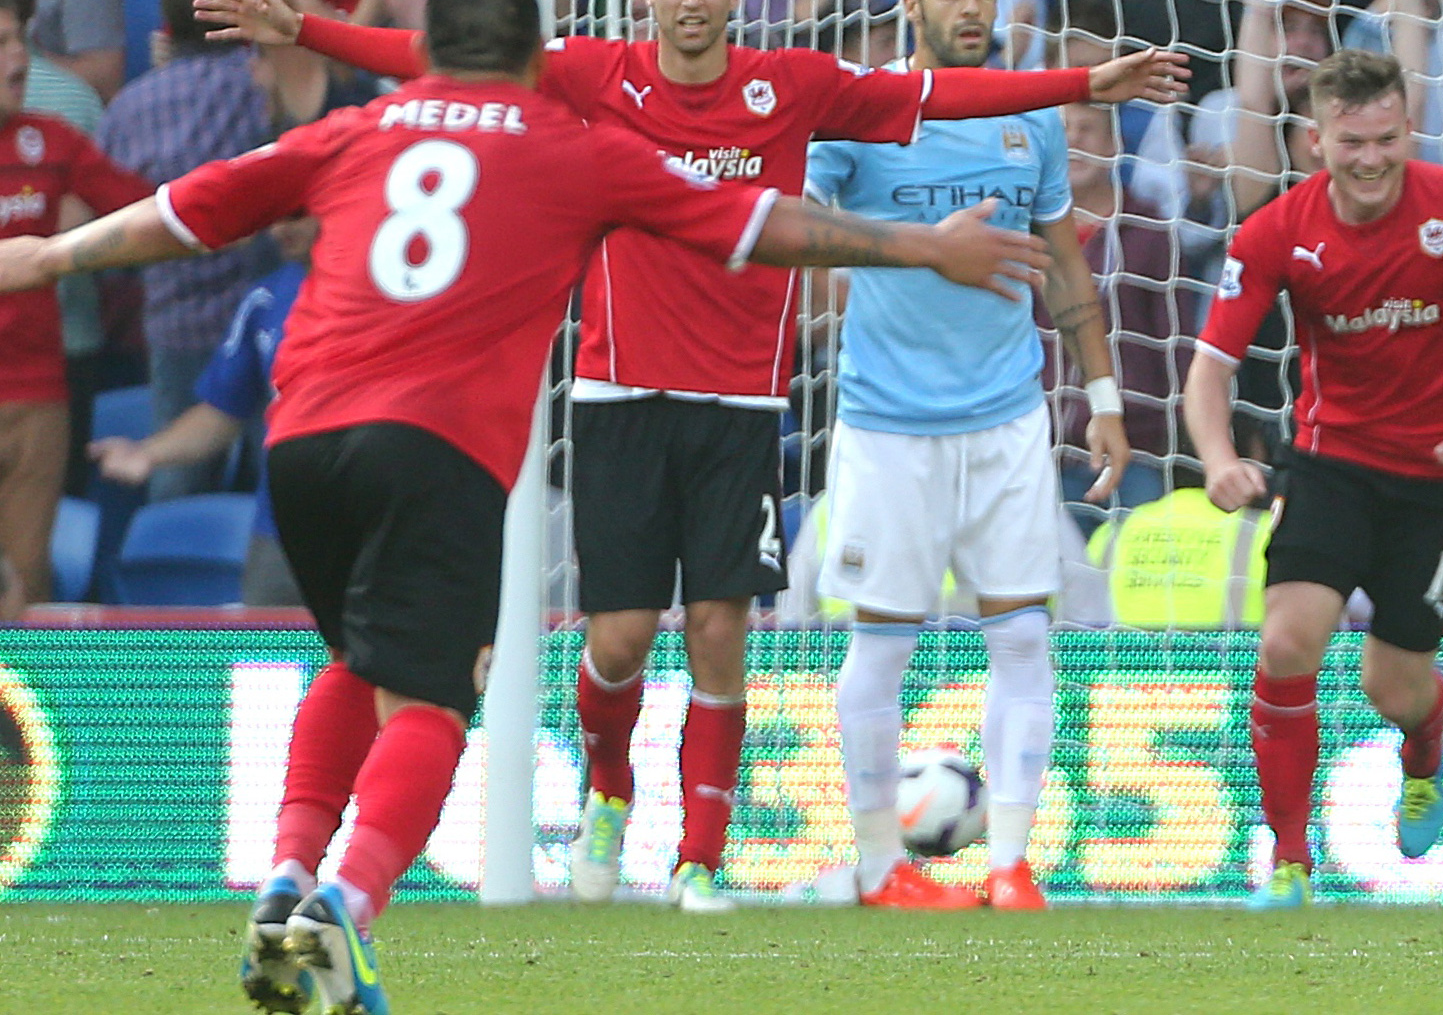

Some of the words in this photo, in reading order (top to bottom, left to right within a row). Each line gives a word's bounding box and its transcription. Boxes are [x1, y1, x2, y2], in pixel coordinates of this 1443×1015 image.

[378, 98, 529, 136] MEDEL
[664, 150, 763, 182] alaysia
[708, 146, 742, 160] visit
[891, 184, 1036, 208] ETIHAD
[366, 137, 482, 305] 8
[1325, 299, 1441, 335] Malaysia
[759, 493, 781, 553] 2
